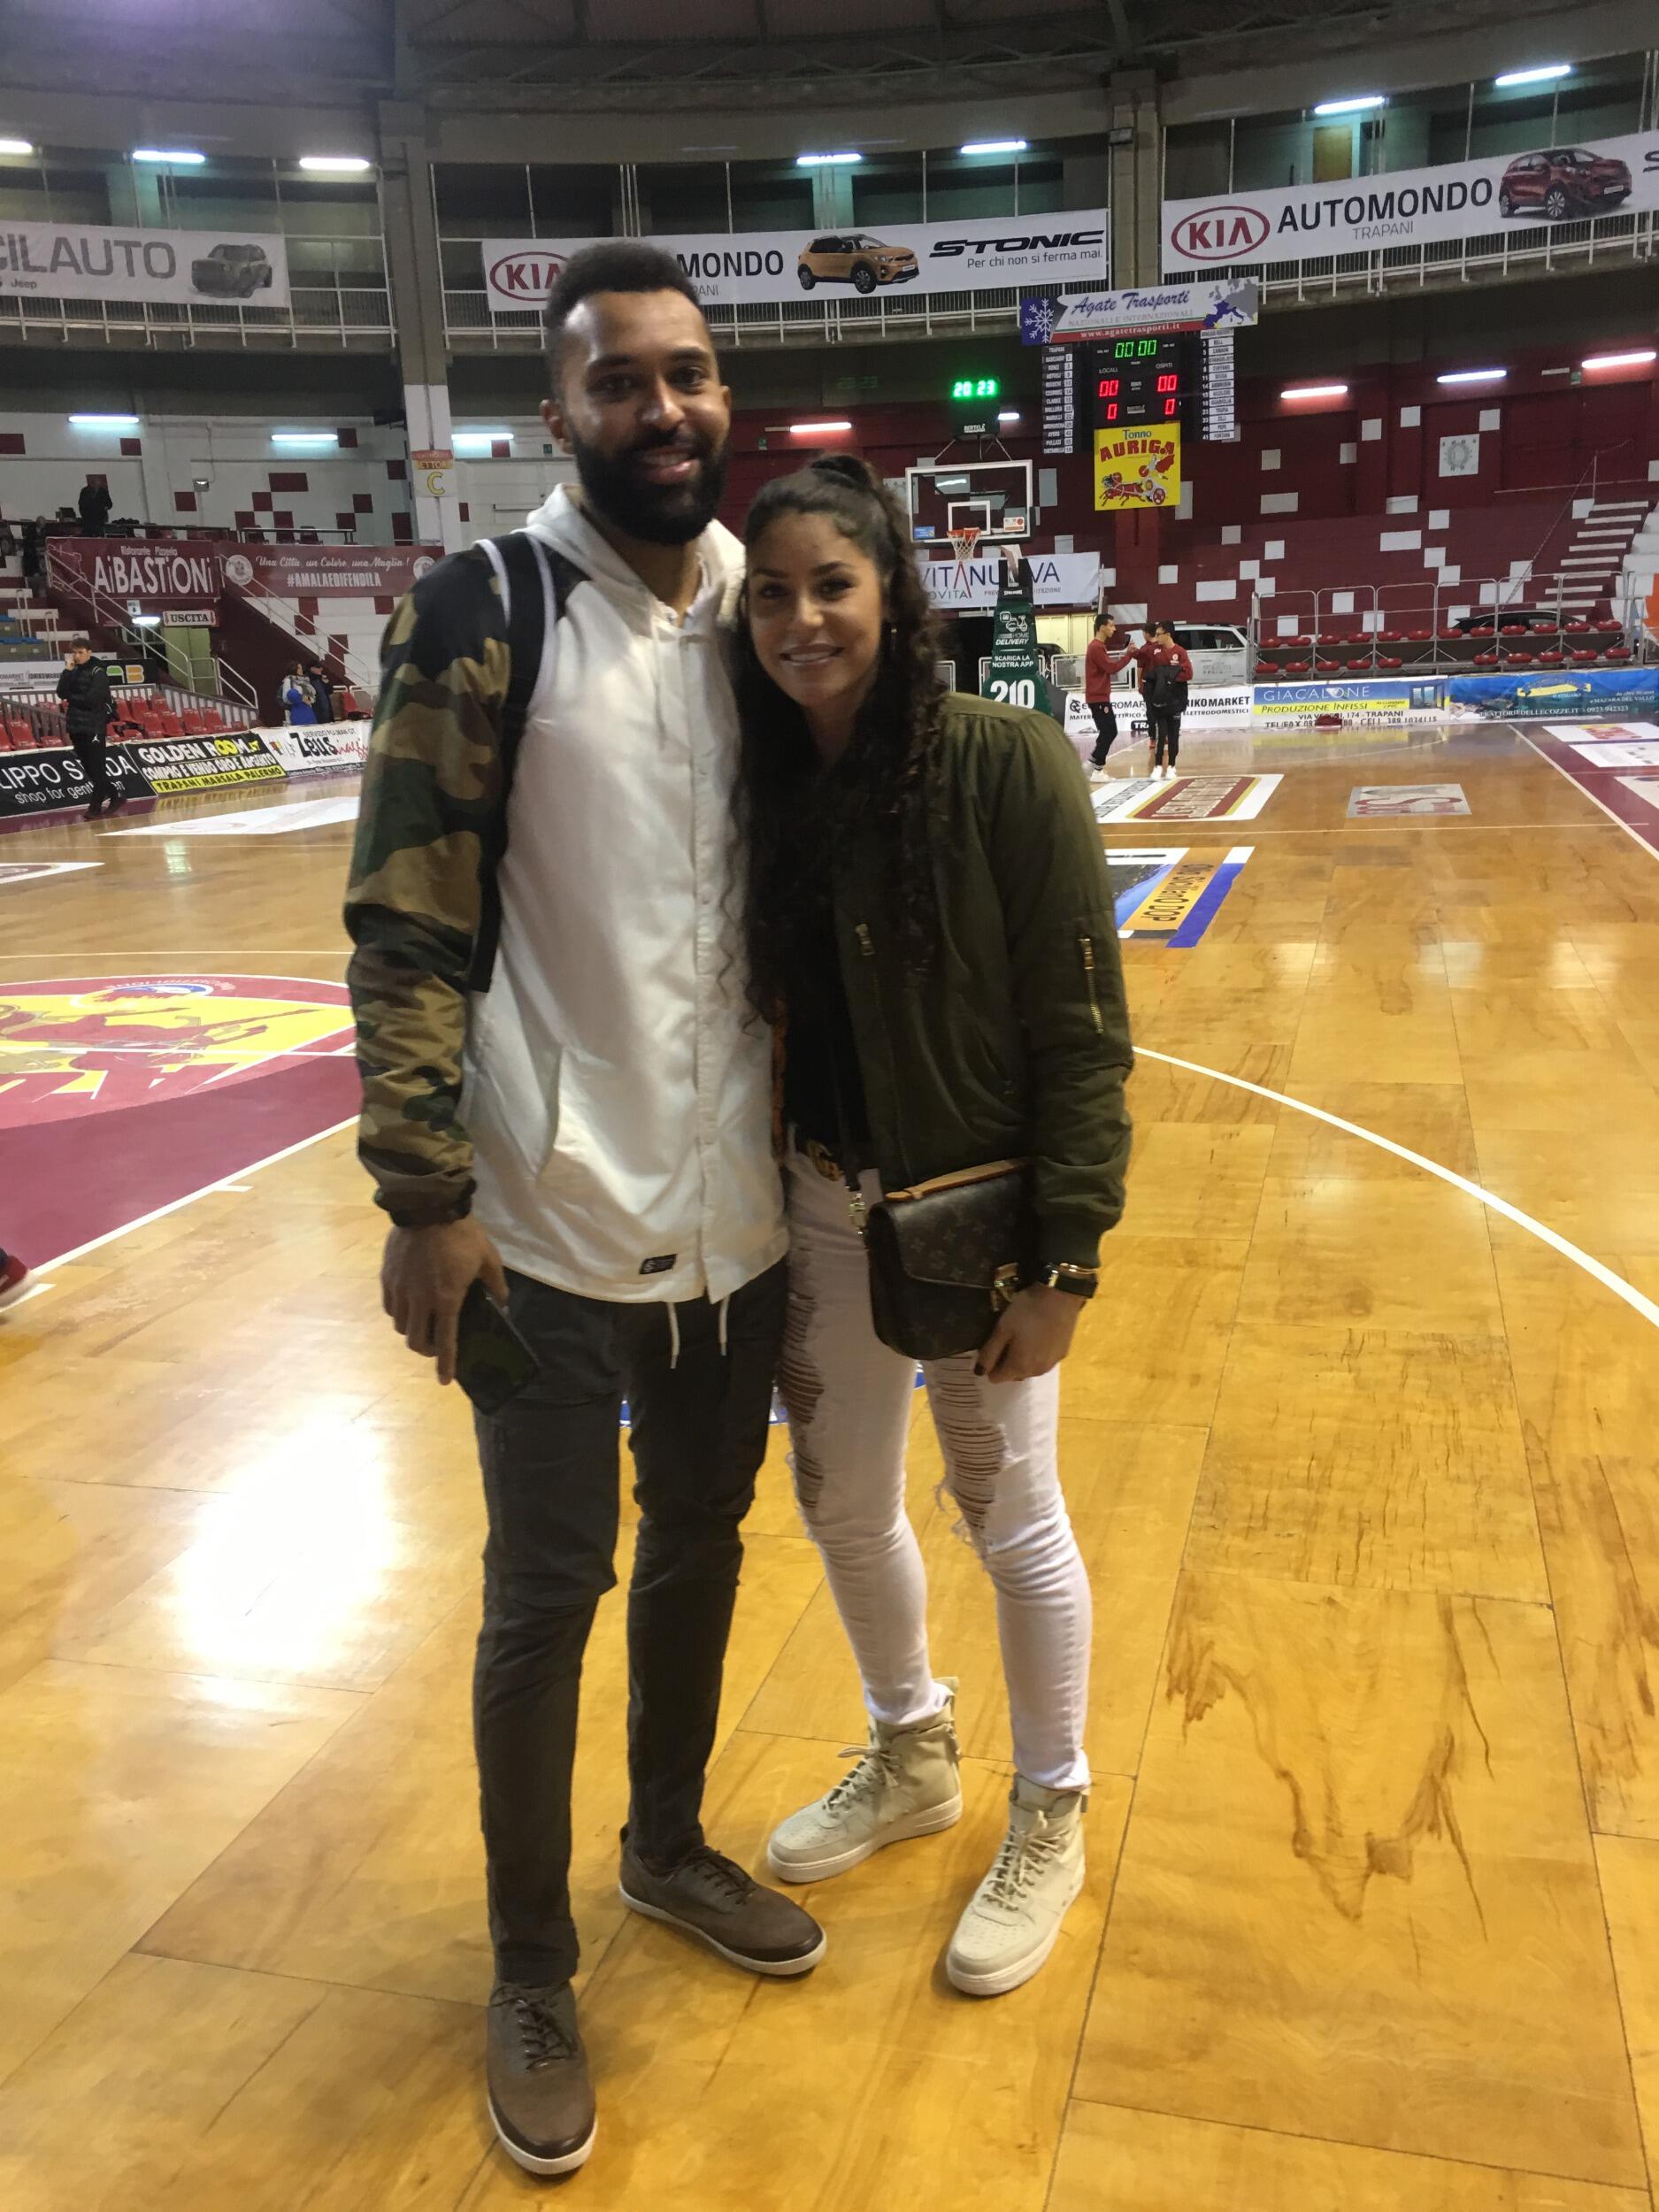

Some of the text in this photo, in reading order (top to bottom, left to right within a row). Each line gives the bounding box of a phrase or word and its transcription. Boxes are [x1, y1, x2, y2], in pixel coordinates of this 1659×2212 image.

[1189, 178, 1492, 250] KIA AUTOMONDO
[1352, 221, 1415, 240] TRAPANI
[929, 230, 1104, 257] STONIC
[0, 229, 177, 280] ILAUTO
[676, 250, 784, 278] MONDO
[967, 247, 1103, 269] Per chi non si ferma mai.
[11, 279, 37, 290] Jeep
[1071, 289, 1190, 319] Agate Trasporti
[1099, 380, 1119, 397] 00
[1157, 375, 1178, 392] 00
[1107, 403, 1118, 420] 0
[1164, 398, 1176, 415] 0
[1123, 429, 1152, 440] Tonno
[427, 472, 445, 495] C
[170, 614, 210, 623] USCITA
[1263, 687, 1371, 702] GIACALONE
[138, 741, 209, 764] GOLDEN
[289, 733, 337, 757] Zeus
[142, 763, 183, 781] COMPRO
[157, 780, 199, 792] TRAPANI
[202, 772, 245, 786] MARSALA
[243, 766, 282, 780] PALERMO
[15, 789, 47, 804] shop
[45, 787, 65, 799] for
